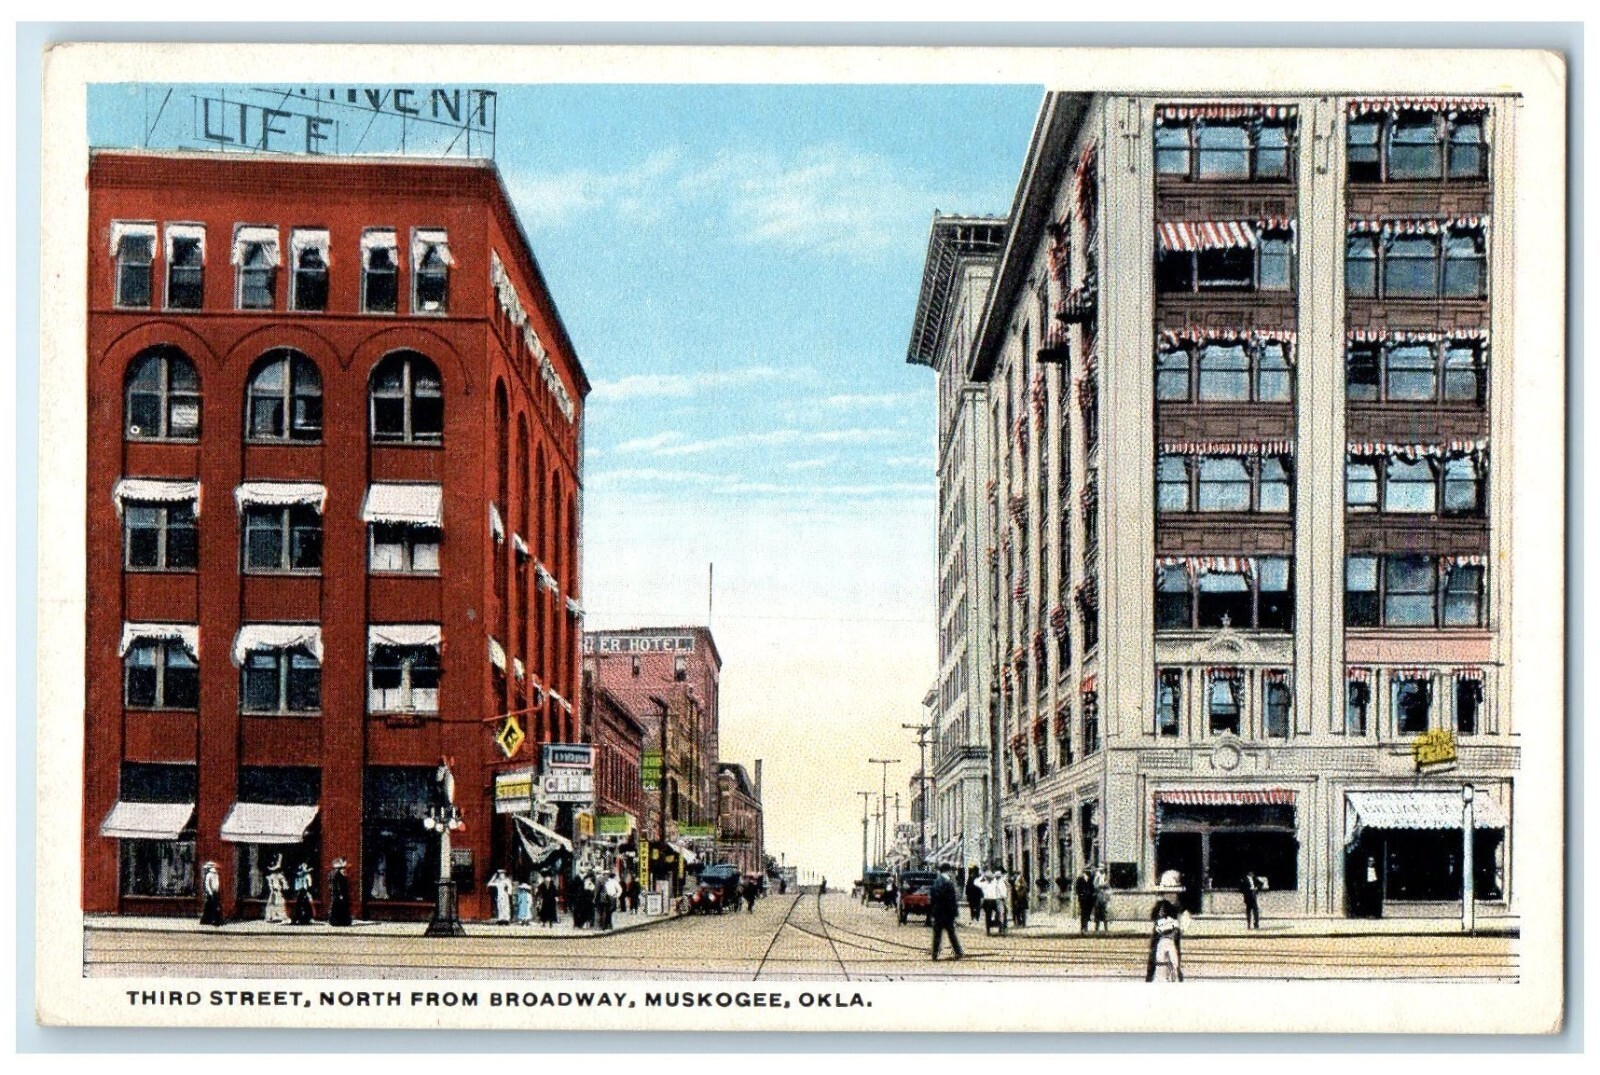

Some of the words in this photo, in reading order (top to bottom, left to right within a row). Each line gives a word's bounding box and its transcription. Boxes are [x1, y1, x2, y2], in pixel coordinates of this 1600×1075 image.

[204, 97, 333, 155] LIFE
[630, 637, 688, 652] HOTEL
[126, 990, 201, 1006] THIRD
[210, 990, 311, 1008] STREET,
[319, 991, 401, 1007] NORTH
[410, 991, 478, 1007] FROM
[490, 992, 636, 1008] BROADWAY,
[645, 992, 790, 1009] MUSKOGEE,
[798, 992, 872, 1008] OKLA.
